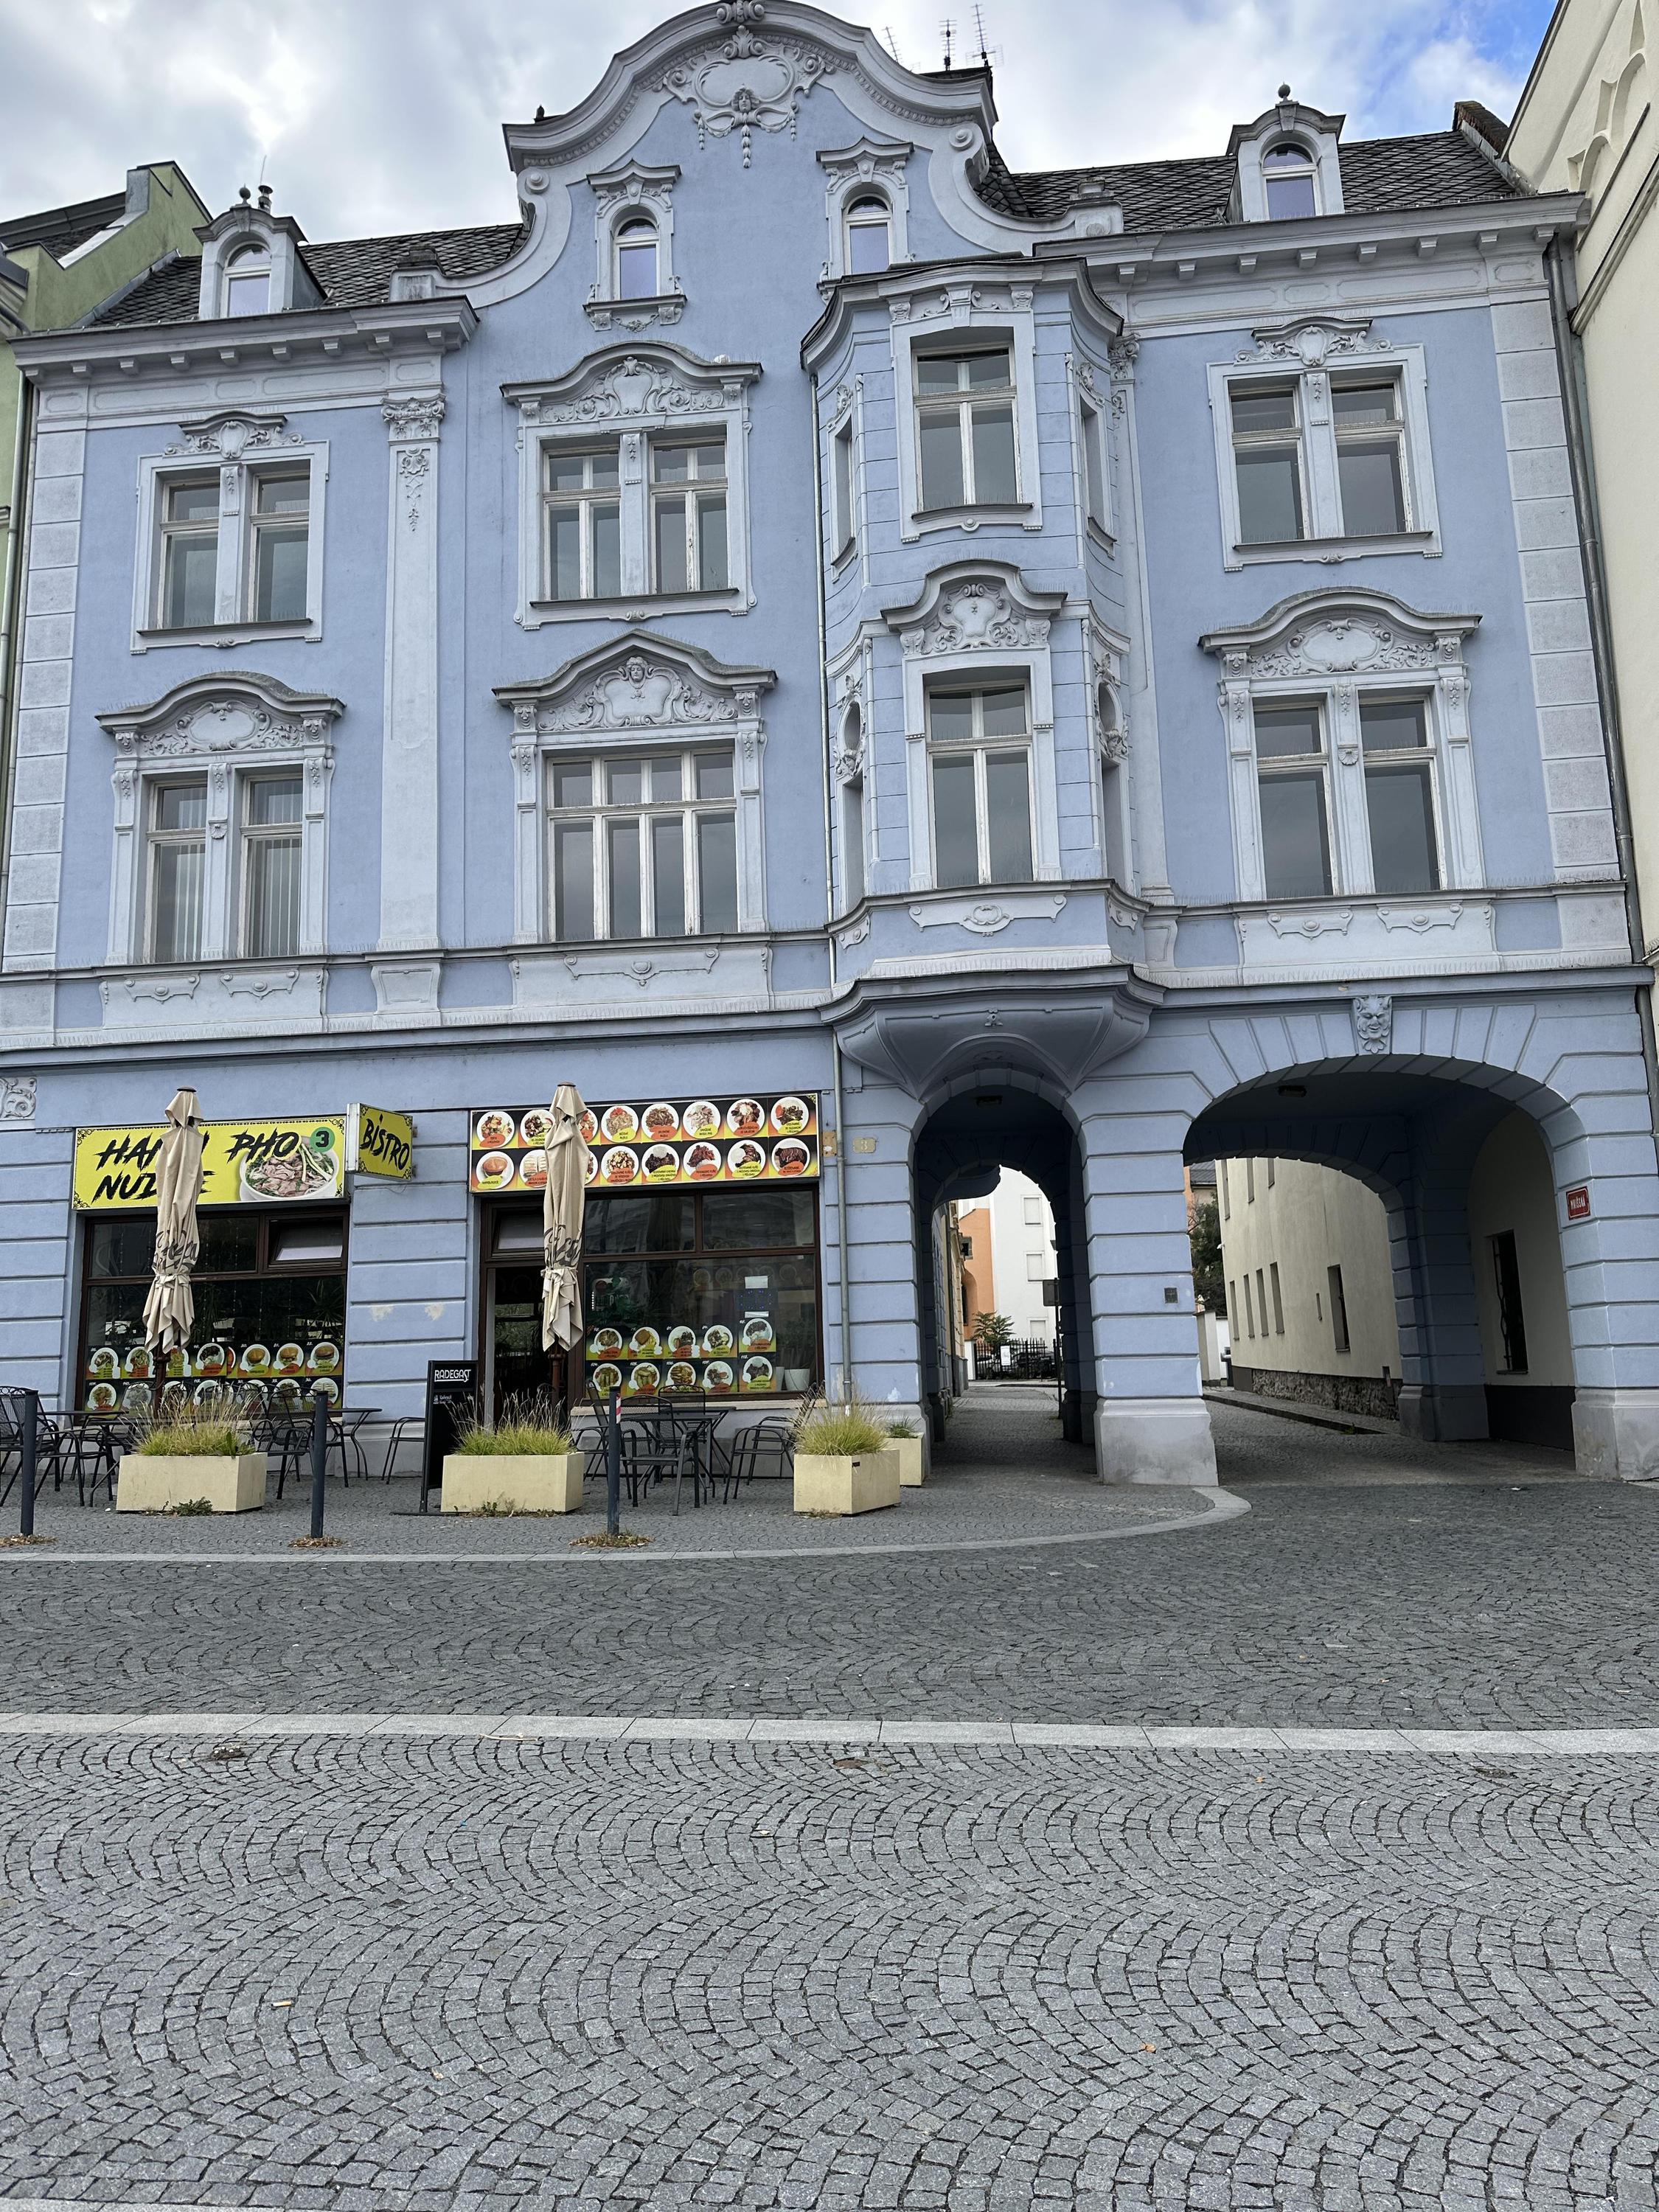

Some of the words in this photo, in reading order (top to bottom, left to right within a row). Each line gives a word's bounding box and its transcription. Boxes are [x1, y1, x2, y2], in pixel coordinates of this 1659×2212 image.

[223, 1127, 299, 1164] PHO
[315, 1130, 330, 1148] 3
[434, 1369, 472, 1382] RADEGAST
